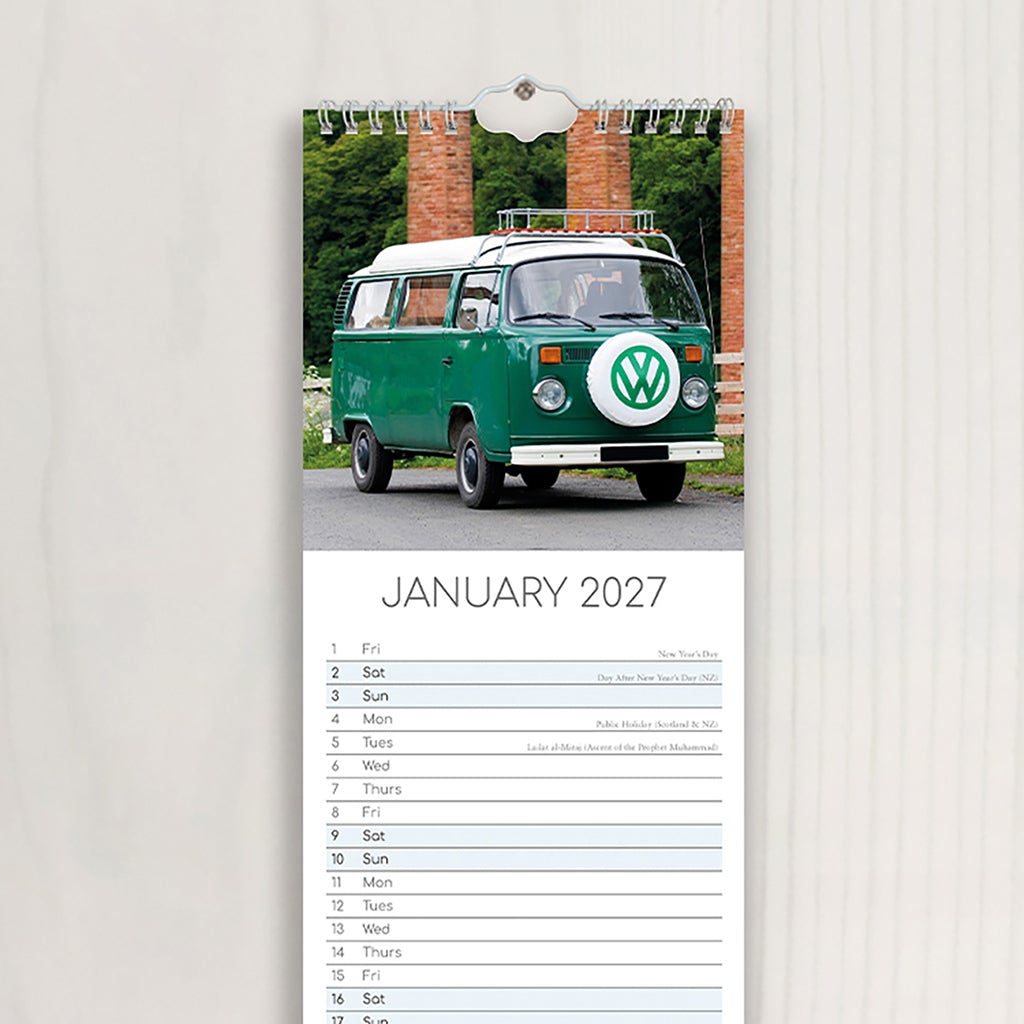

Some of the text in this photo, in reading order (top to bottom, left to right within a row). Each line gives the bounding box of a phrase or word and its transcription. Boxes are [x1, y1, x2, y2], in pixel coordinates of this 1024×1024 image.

[611, 345, 670, 410] VW
[381, 575, 668, 609] JANUARY 2027
[331, 643, 381, 654] 1 Fri
[658, 649, 677, 658] New
[702, 649, 719, 659] Day
[331, 666, 386, 679] 2 Sat
[597, 673, 613, 683] Day
[636, 673, 655, 681] New
[680, 673, 697, 683] Day
[330, 689, 389, 702] 3 Sun
[330, 713, 393, 725] 4 Mon
[331, 736, 394, 748] 5 Tues
[613, 743, 623, 751] of
[623, 743, 636, 751] the
[331, 760, 391, 771] 6 Wed
[331, 783, 403, 795] 7 Thurs
[330, 806, 381, 818] 8 Fri
[330, 829, 386, 841] 9 Sat
[331, 852, 389, 865] 10 Sun
[331, 876, 393, 888] 11 Mon
[331, 899, 394, 912] 12 Tues
[331, 923, 391, 935] 13 Wed
[331, 946, 403, 958] 14 Thurs
[331, 969, 381, 981] 15 Fri
[331, 992, 386, 1005] 16 Sat
